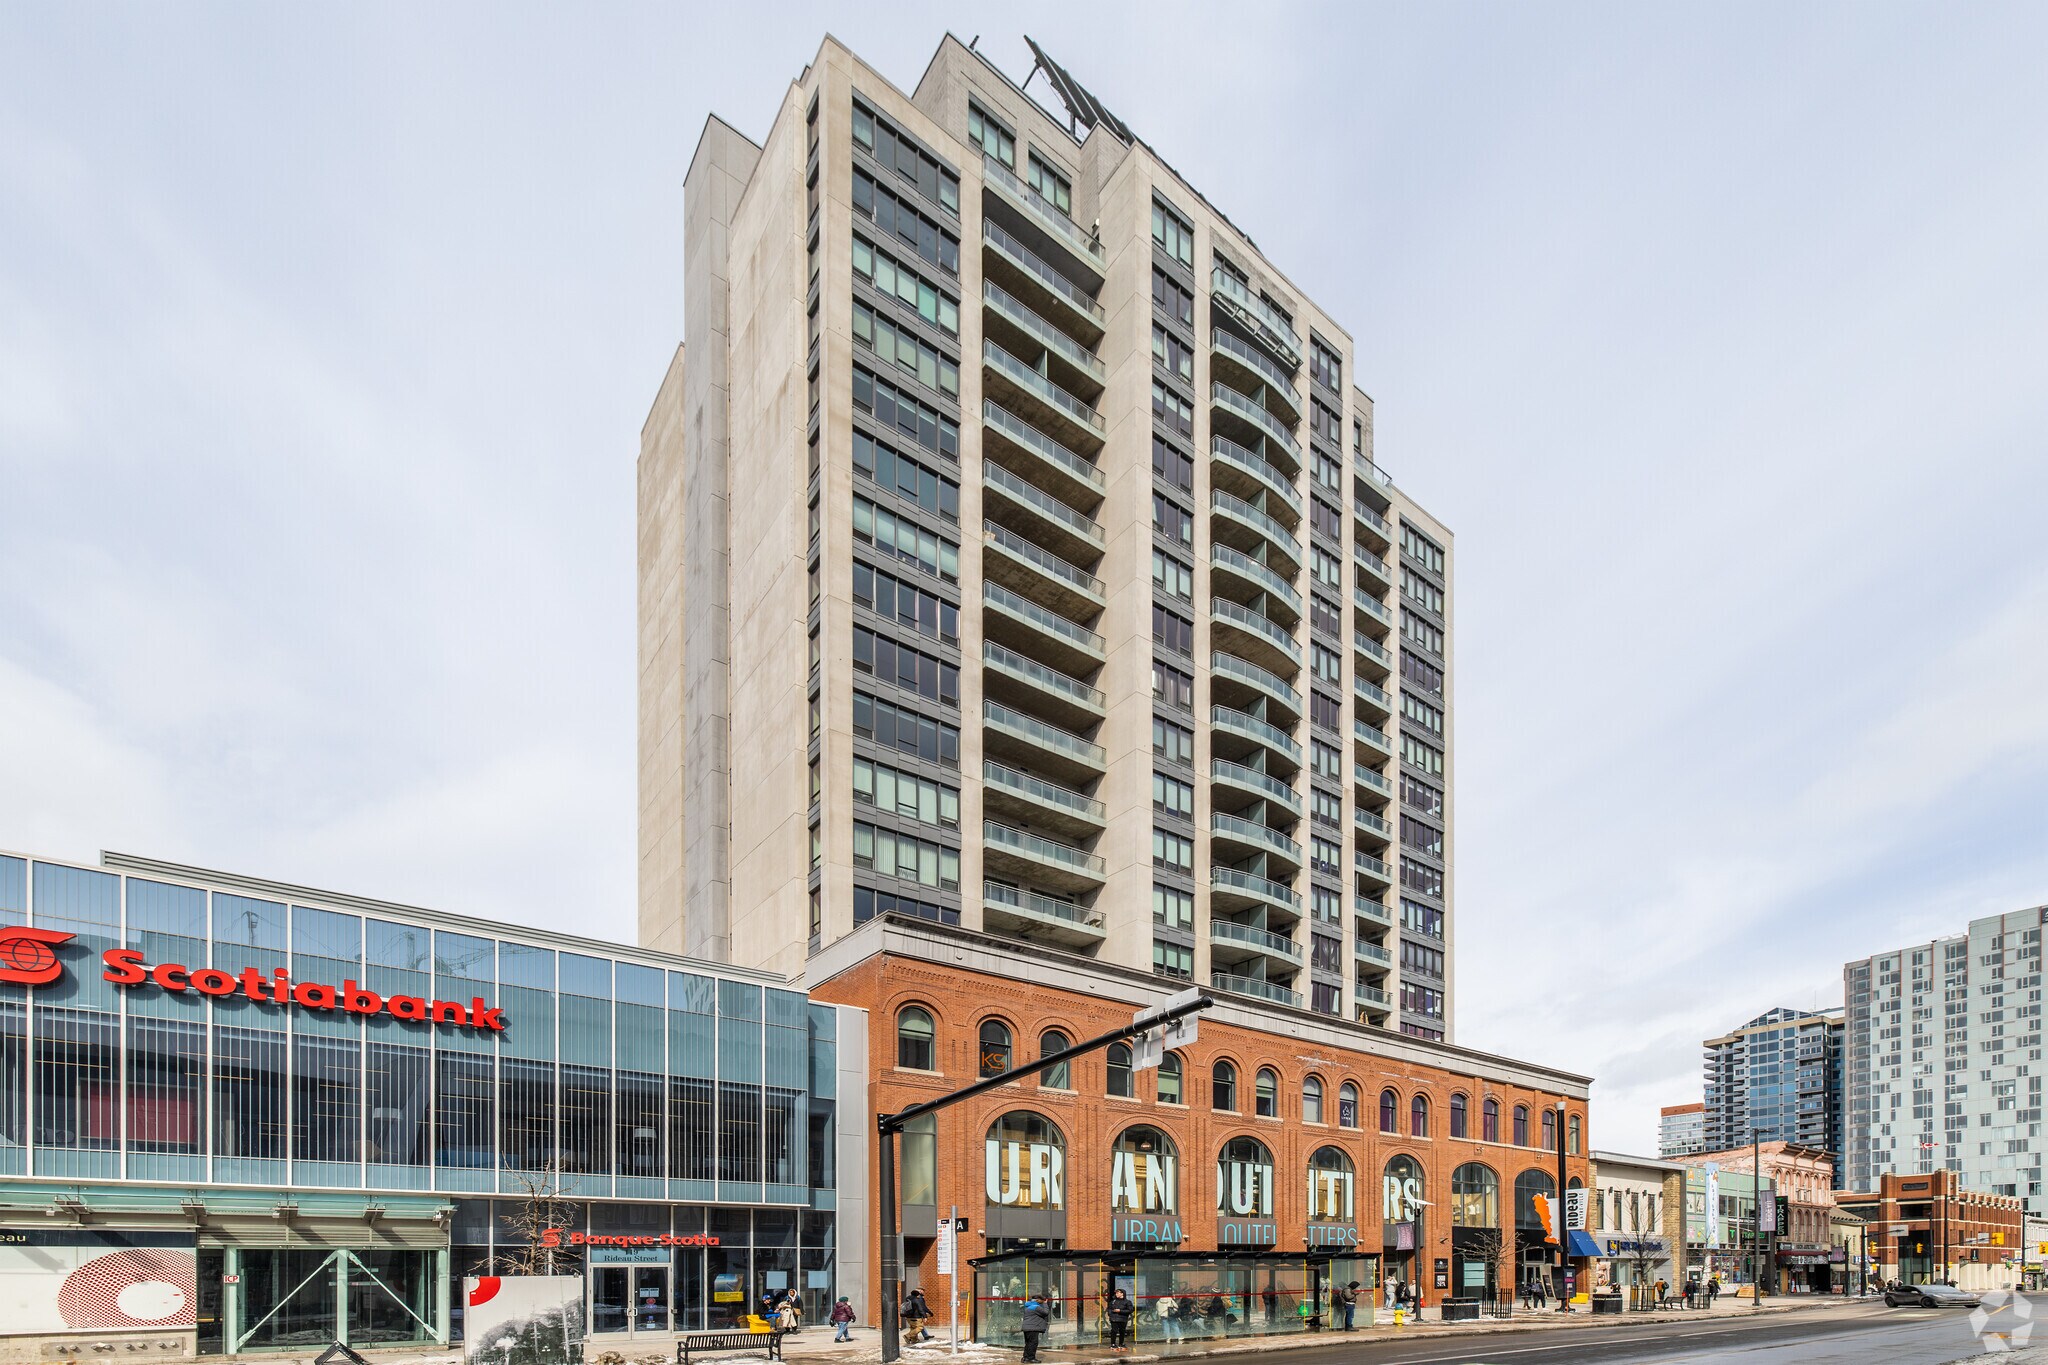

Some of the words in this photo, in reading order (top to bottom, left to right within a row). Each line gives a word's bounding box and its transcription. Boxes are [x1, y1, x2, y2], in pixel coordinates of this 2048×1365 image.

[102, 948, 505, 1031] Scotiabank
[981, 1052, 1005, 1069] KS
[956, 1220, 964, 1230] A
[1778, 1204, 1786, 1236] TRAPPED
[570, 1231, 655, 1248] Banque
[659, 1233, 720, 1246] Scotia
[224, 1275, 239, 1283] ICP
